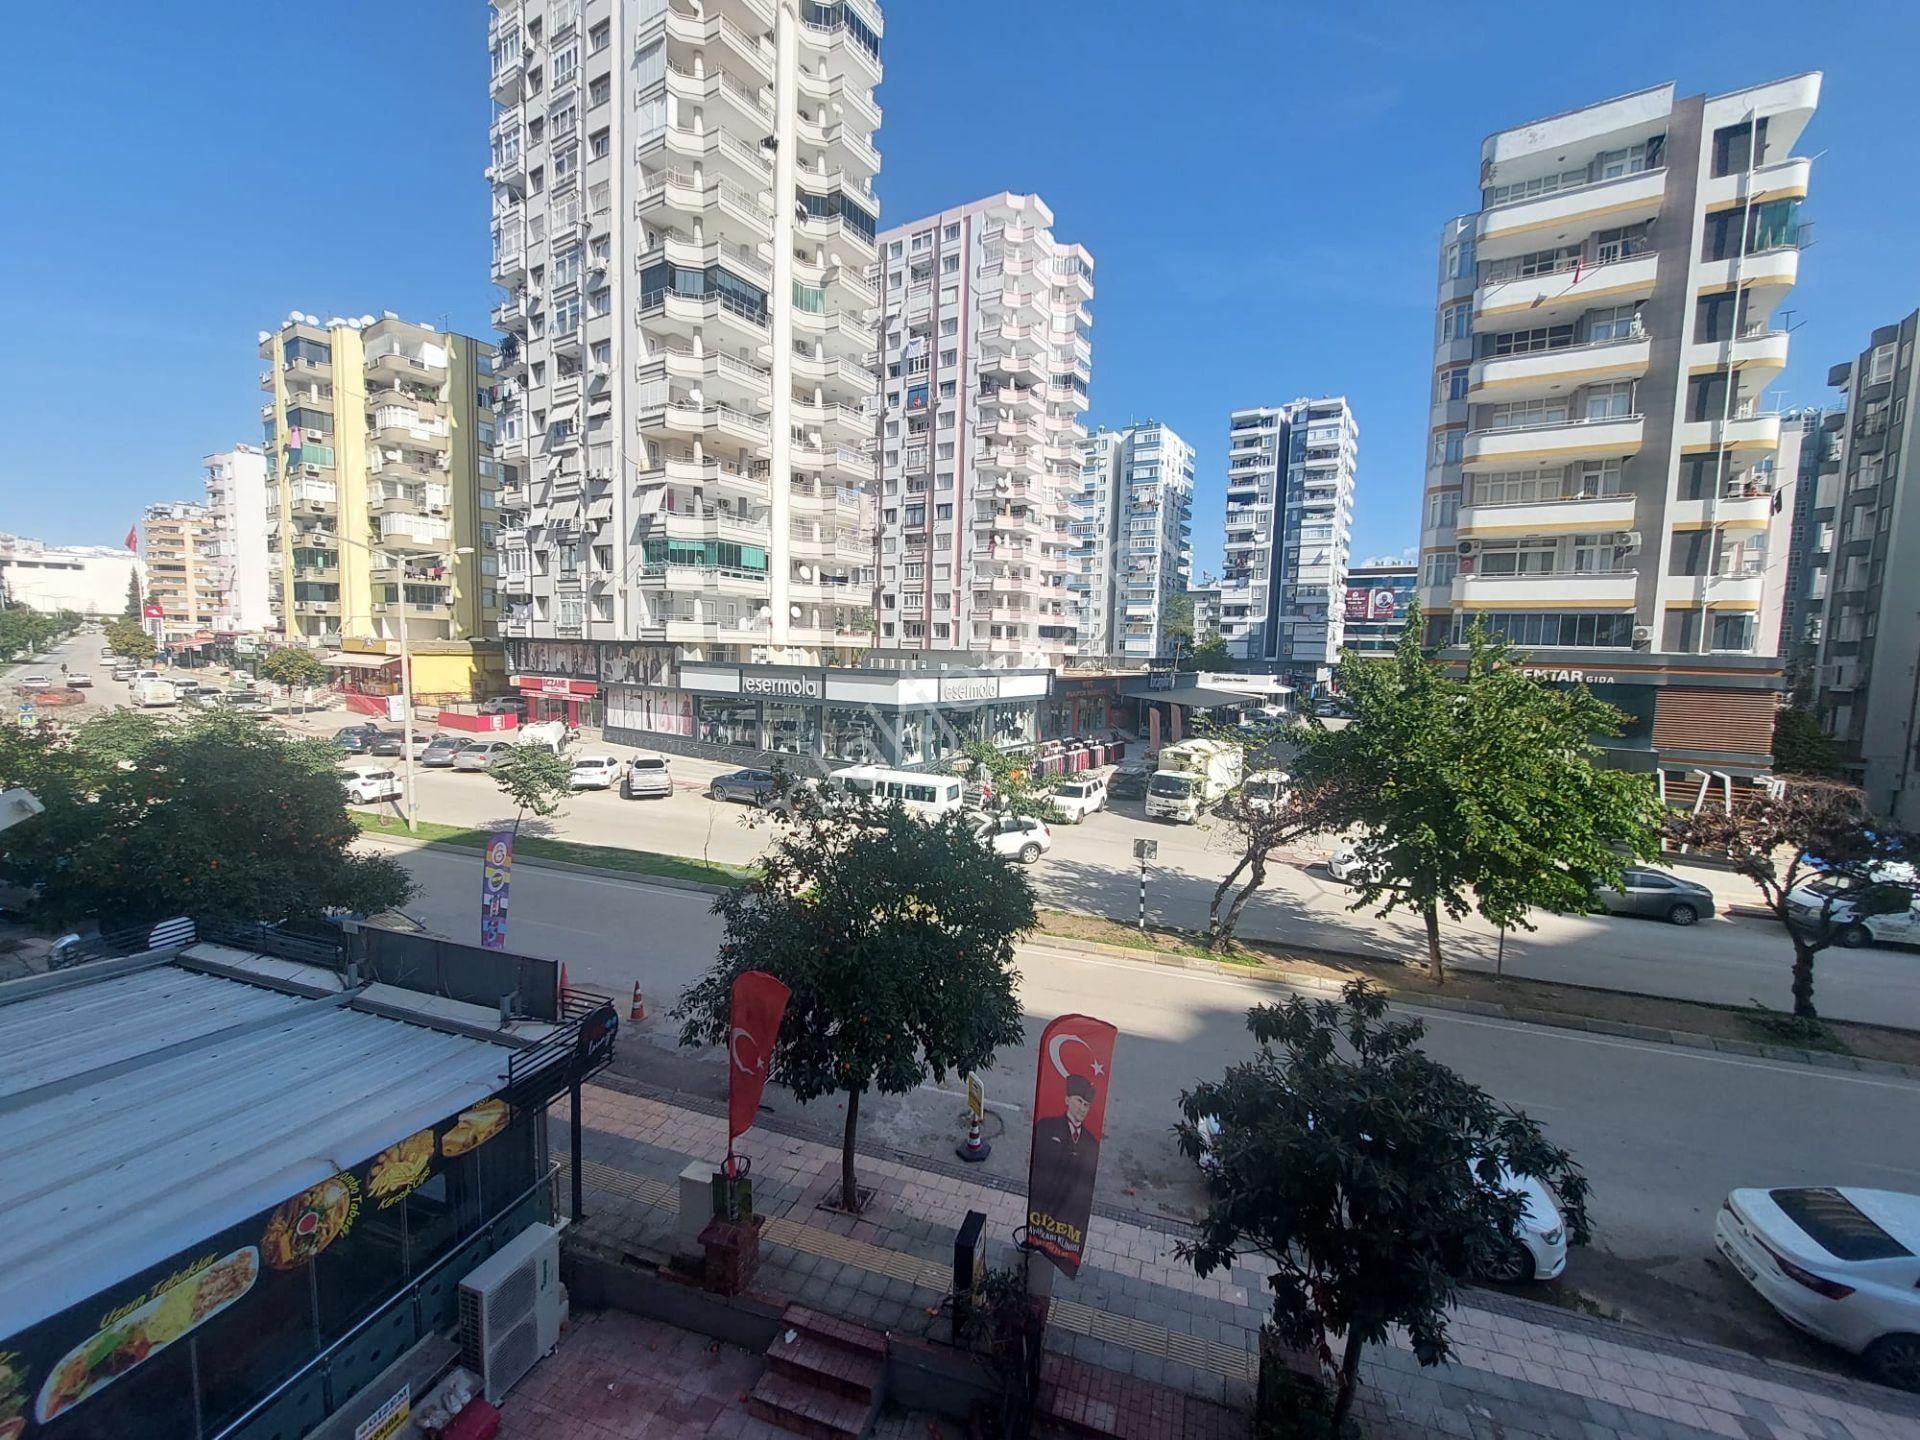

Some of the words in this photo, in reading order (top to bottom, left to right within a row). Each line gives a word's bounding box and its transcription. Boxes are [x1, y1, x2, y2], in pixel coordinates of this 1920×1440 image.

[745, 674, 817, 696] esermola
[944, 679, 995, 700] esermola
[1586, 676, 1615, 684] GIDA
